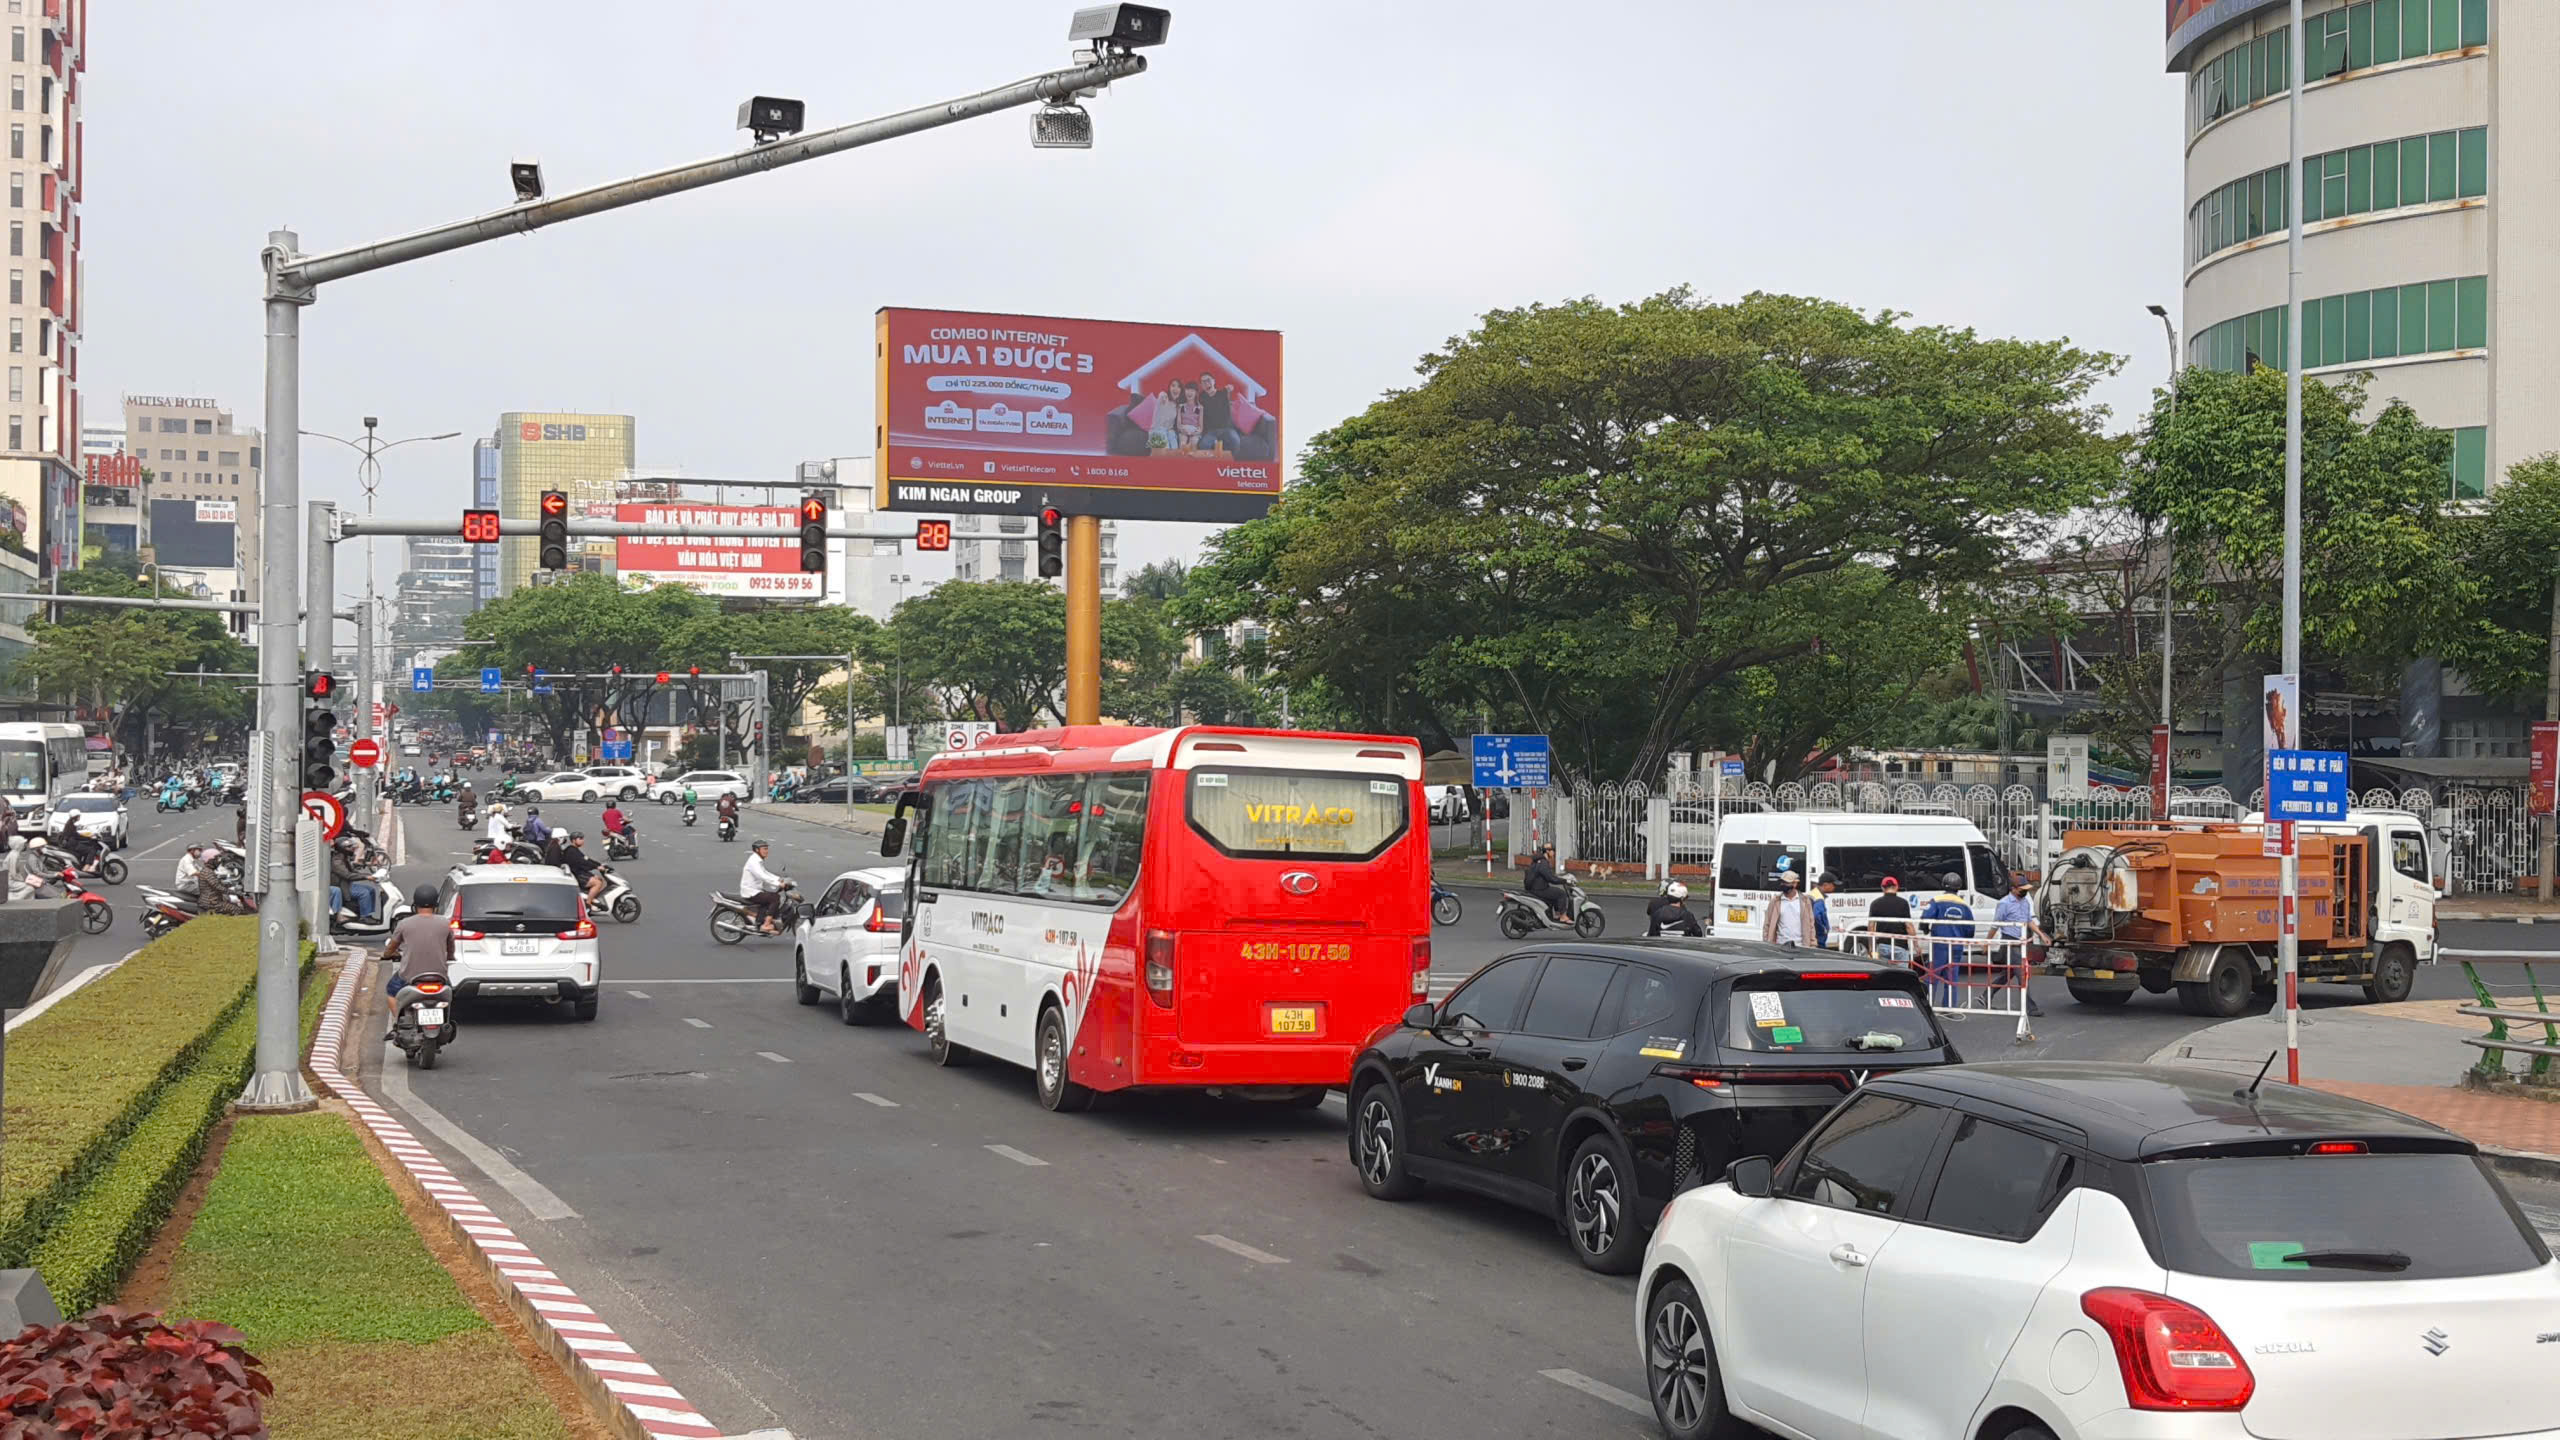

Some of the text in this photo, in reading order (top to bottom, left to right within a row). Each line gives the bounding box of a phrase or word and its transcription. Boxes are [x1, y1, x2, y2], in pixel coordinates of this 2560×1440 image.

[930, 327, 1069, 348] COMBO INTERNET
[903, 344, 1094, 374] MUA 1 ĐƯỢC 3
[127, 395, 218, 409] MITISA HOTEL
[927, 416, 971, 426] INTERNET
[1030, 420, 1068, 430] CAMERA
[543, 424, 586, 441] SHB
[1217, 466, 1268, 479] viettel
[1237, 481, 1268, 489] telecom
[899, 486, 1021, 504] KIM NGAN GROUP
[695, 509, 719, 527] PHÁT
[465, 513, 497, 540] 68
[919, 522, 949, 548] 28
[741, 552, 763, 568] NAM
[749, 577, 813, 590] 0932 56 59 56
[1246, 801, 1356, 826] VITRACO
[971, 911, 1004, 936] VITRACO
[1241, 943, 1351, 961] 43H-107.58
[1284, 1009, 1303, 1020] 43H
[1278, 1020, 1311, 1031] 107.58
[1434, 1076, 1452, 1090] XANH
[1512, 1072, 1528, 1087] 1900
[2254, 1342, 2318, 1354] SUZUKI
